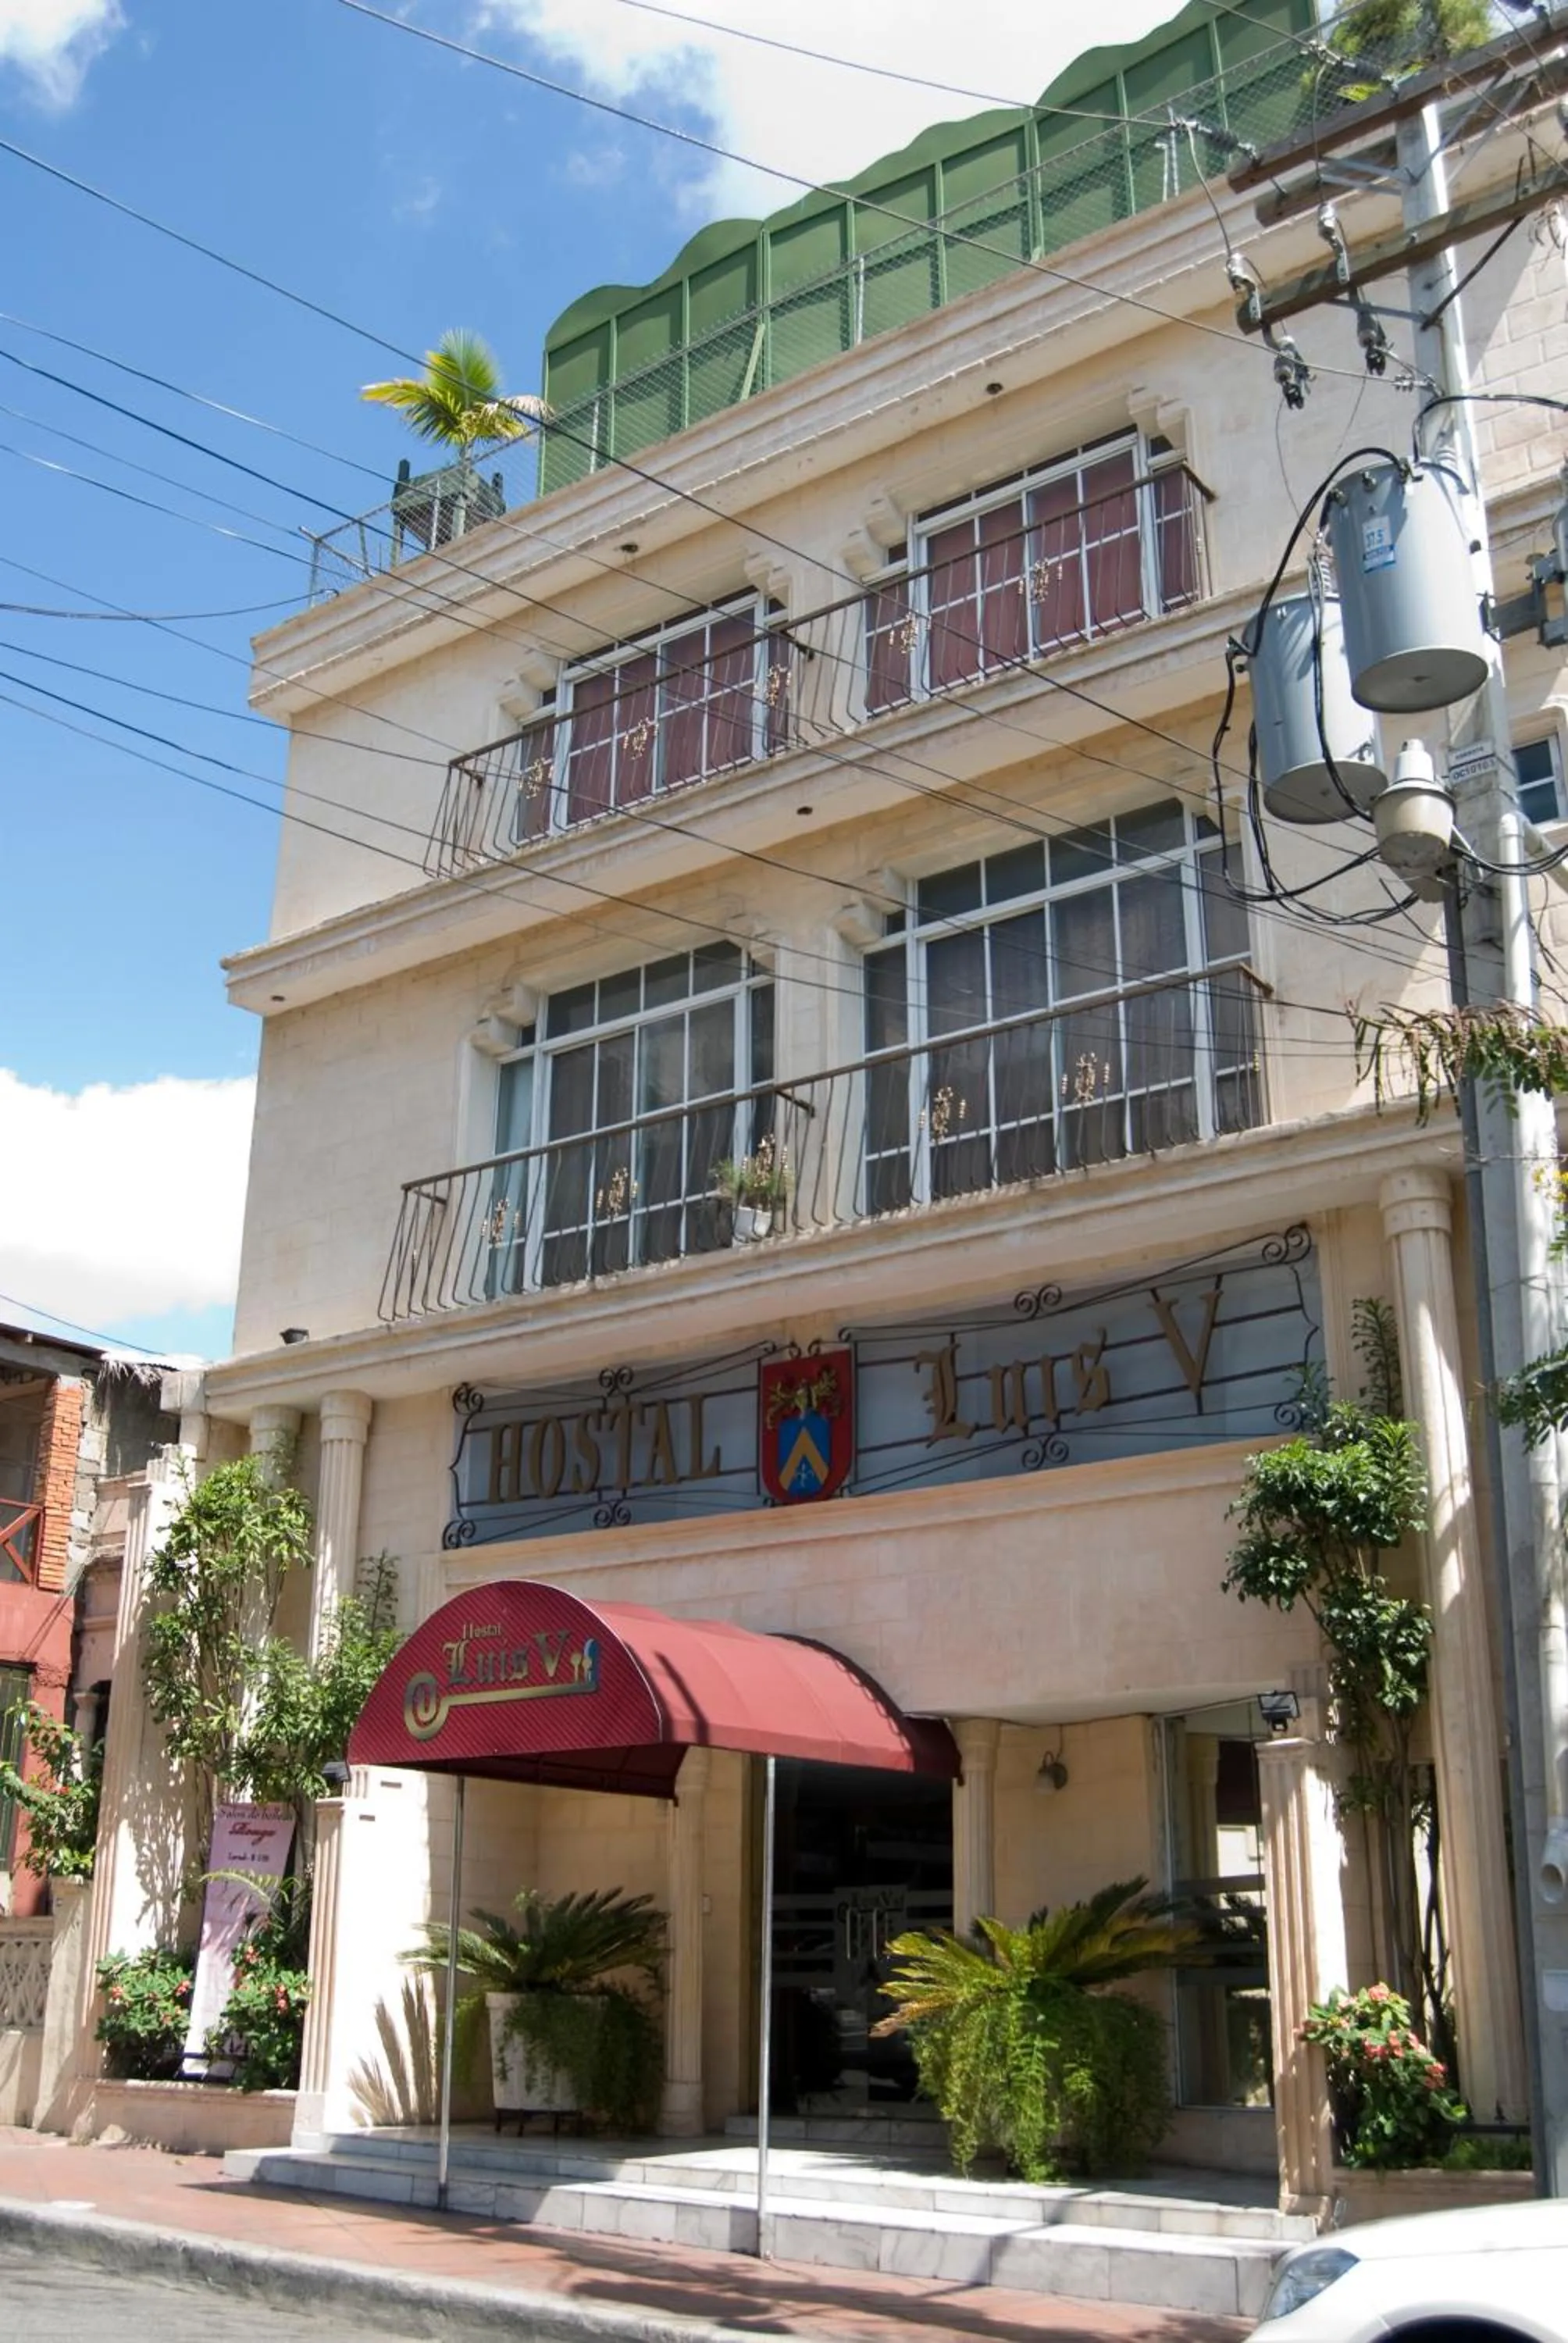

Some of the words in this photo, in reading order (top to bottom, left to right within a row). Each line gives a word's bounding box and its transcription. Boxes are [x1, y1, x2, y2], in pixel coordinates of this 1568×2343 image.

[486, 1393, 722, 1504] HOSTAL
[914, 1326, 1112, 1449] Luis
[1146, 1288, 1224, 1395] V
[442, 1639, 529, 1684] Luis
[532, 1629, 571, 1678] V
[462, 1623, 501, 1640] Hostal
